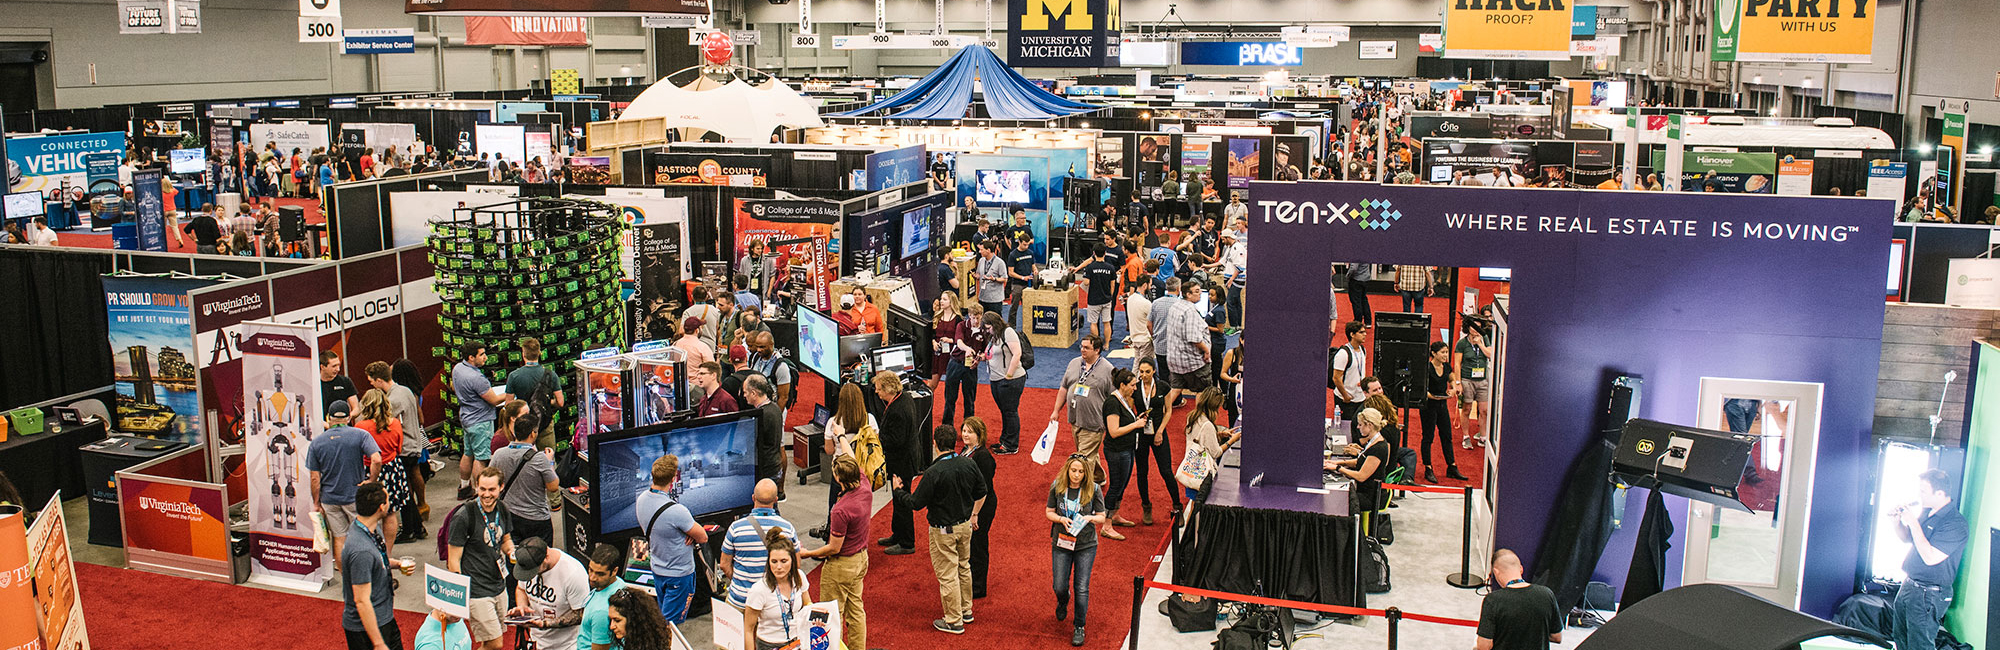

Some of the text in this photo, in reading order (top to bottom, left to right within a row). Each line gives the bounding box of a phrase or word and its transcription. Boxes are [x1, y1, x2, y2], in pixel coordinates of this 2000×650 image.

[1021, 0, 1093, 30] M
[1745, 0, 1868, 18] PARTY
[511, 17, 577, 32] INNOVATION
[1485, 15, 1534, 24] PROOF?
[308, 23, 334, 37] 500
[1781, 22, 1837, 32] WITH US
[695, 33, 708, 42] 70
[797, 37, 815, 45] 800
[1020, 37, 1082, 45] UNIVERSITY
[1020, 46, 1092, 57] MICHIGAN
[1239, 43, 1300, 66] BRASIL
[41, 139, 108, 151] CONNECTED
[1696, 156, 1735, 165] Hanover
[657, 166, 761, 175] BASTROP COUNTY
[768, 206, 794, 216] College
[795, 205, 802, 213] of
[803, 206, 817, 214] Arts
[824, 208, 840, 216] Media
[1445, 212, 1529, 232] WHERE
[1538, 216, 1597, 234] REAL
[1607, 218, 1698, 237] ESTATE
[1711, 221, 1733, 239] IS
[643, 239, 663, 247] College
[660, 243, 678, 251] Media
[633, 259, 642, 297] Colorado
[815, 238, 827, 308] MIRROR WORLDS
[107, 292, 188, 308] PR SHOULD GROW YO
[211, 292, 261, 313] VirginiaTech
[634, 298, 642, 306] of
[290, 294, 398, 332] HNOLOGY
[1033, 310, 1057, 319] M city
[118, 315, 129, 323] NOT
[130, 315, 146, 323] JUST
[158, 316, 173, 324] YOUR
[634, 308, 644, 343] University
[148, 497, 202, 516] VirginiaTech
[265, 547, 308, 559] Application Specific
[277, 543, 300, 551] Humanoid
[262, 553, 284, 561] Protective
[296, 558, 312, 566] Panels
[439, 585, 464, 600] TripRiff
